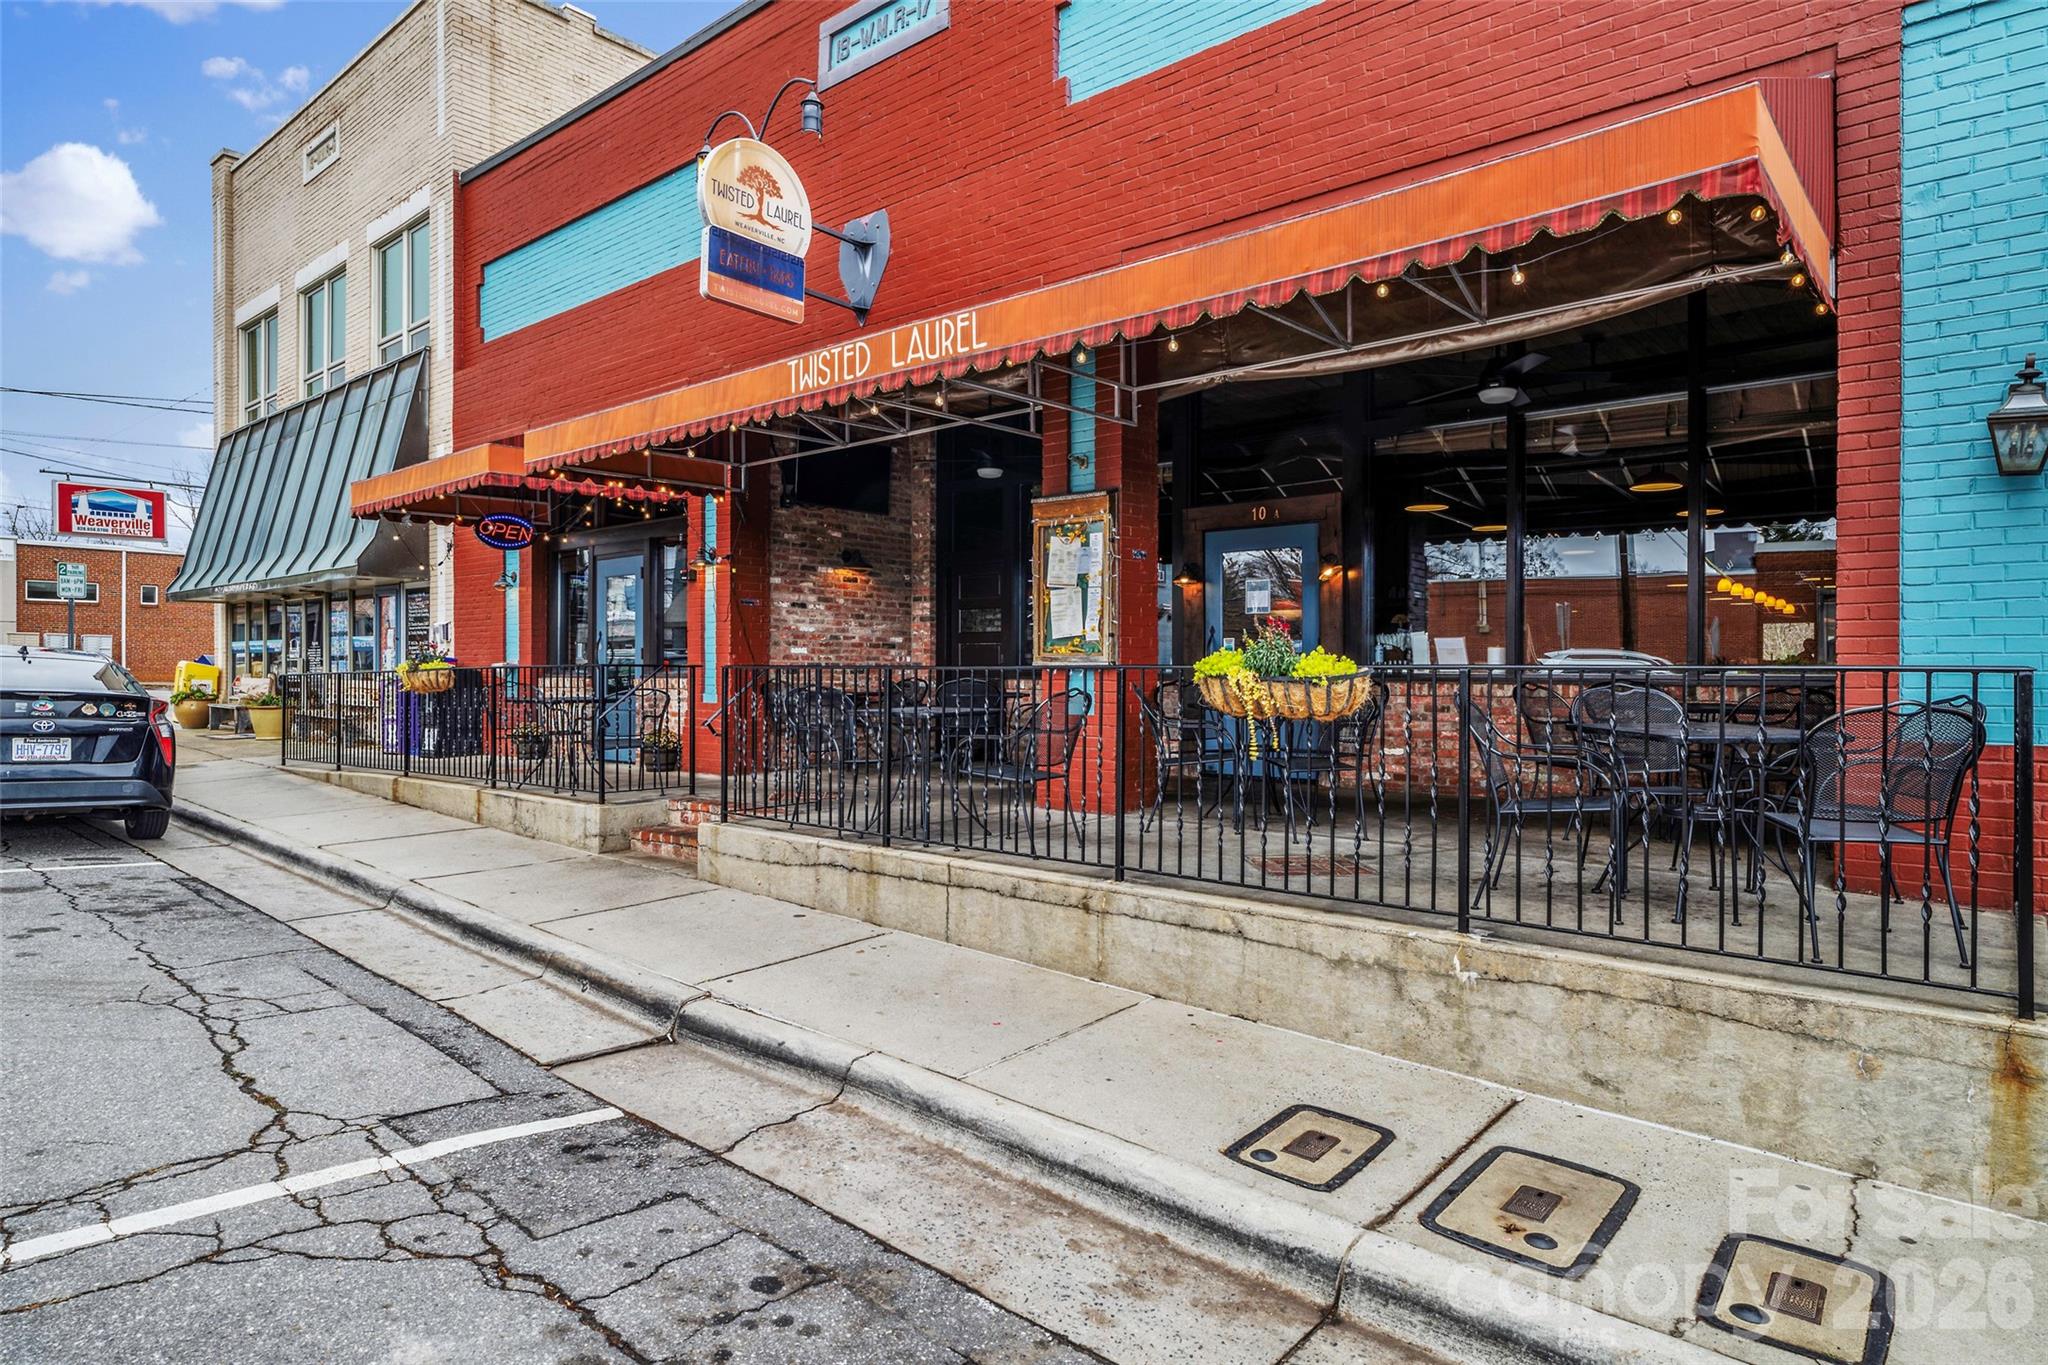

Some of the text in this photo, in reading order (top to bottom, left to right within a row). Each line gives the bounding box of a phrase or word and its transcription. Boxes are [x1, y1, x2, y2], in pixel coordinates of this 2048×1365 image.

[711, 178, 806, 231] TWISTED LAUREL
[777, 235, 785, 244] NC
[787, 311, 988, 394] TWISTED LAUREL
[1251, 506, 1267, 521] 10
[74, 514, 151, 531] Weaverville
[111, 527, 151, 536] REALTY
[480, 520, 534, 542] OPEN
[59, 564, 67, 575] 2
[16, 744, 68, 755] HHV-7797
